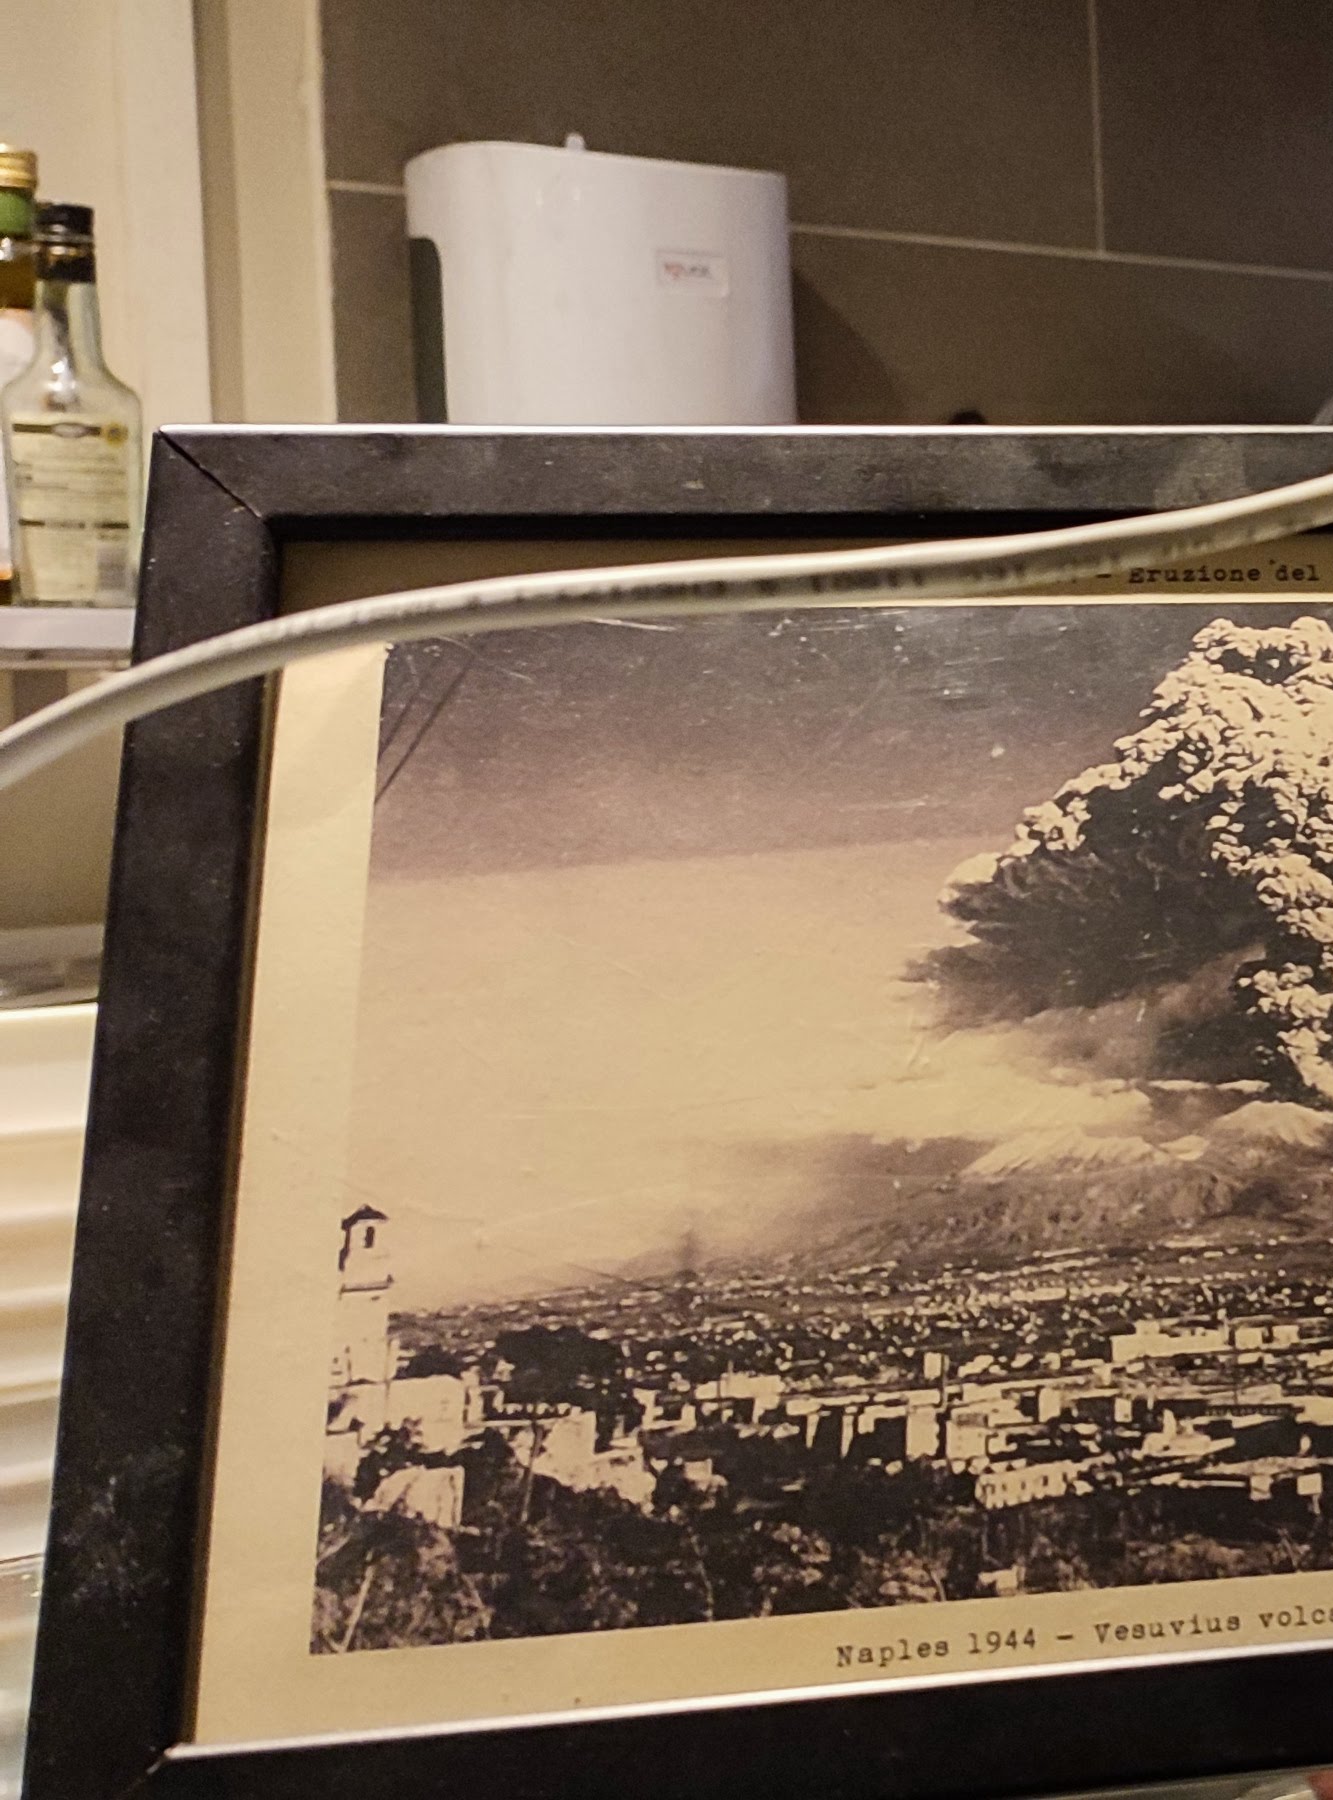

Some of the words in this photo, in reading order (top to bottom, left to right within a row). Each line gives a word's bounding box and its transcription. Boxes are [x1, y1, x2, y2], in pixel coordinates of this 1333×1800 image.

[1127, 565, 1261, 584] Eruzione
[1273, 564, 1320, 582] del
[836, 1638, 950, 1668] Naples
[967, 1627, 1036, 1655] 1944
[1094, 1612, 1241, 1644] Vesuvius
